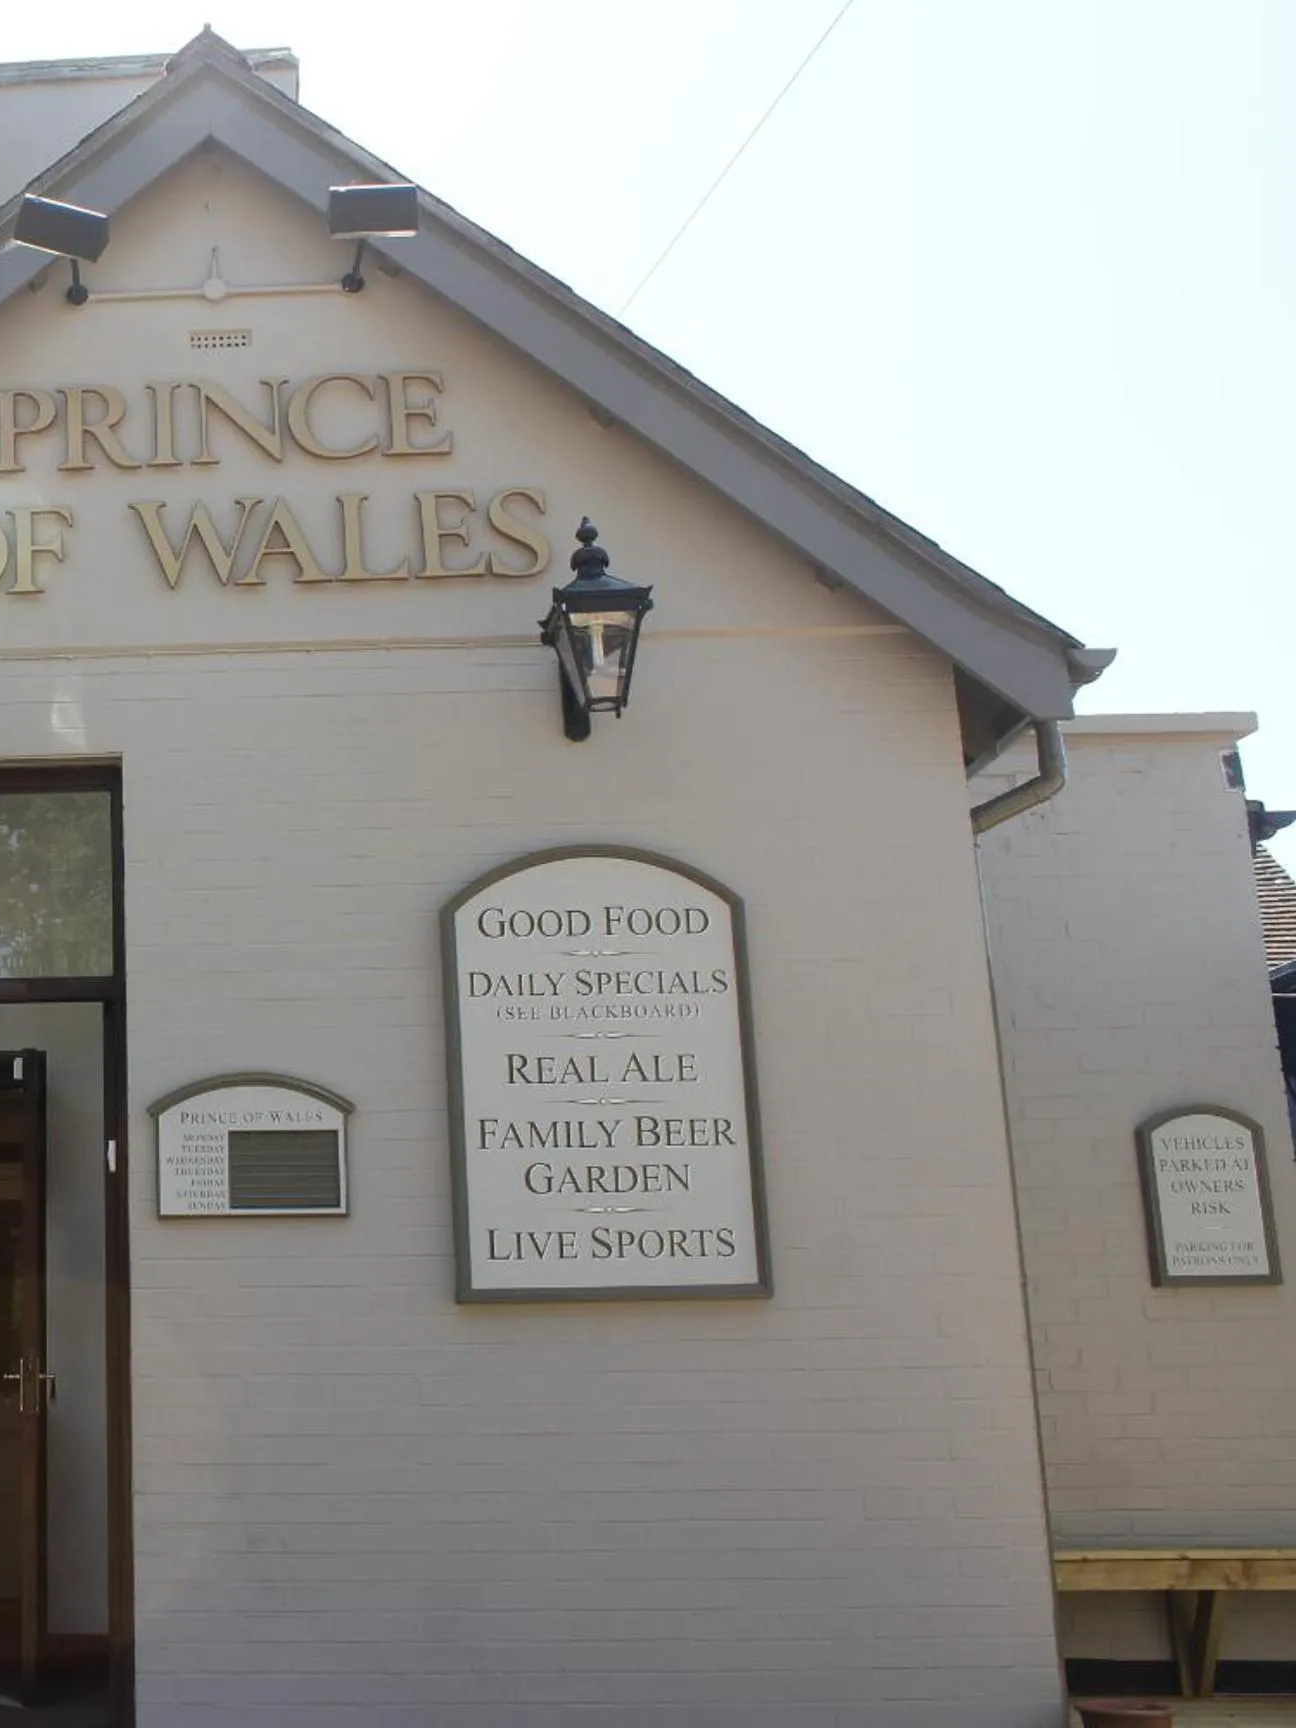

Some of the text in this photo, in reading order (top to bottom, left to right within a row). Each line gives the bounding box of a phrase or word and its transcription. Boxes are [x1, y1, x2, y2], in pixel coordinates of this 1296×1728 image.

[127, 487, 551, 590] WALES
[477, 906, 710, 940] GOOD FOOD
[468, 970, 729, 998] DAILY SPECIALS
[549, 1004, 700, 1021] BLACKBOARD)
[506, 1053, 698, 1085] REAL ALE
[180, 1111, 237, 1125] PRINCE
[270, 1111, 324, 1124] WALES
[478, 1116, 737, 1150] FAMILY BEER
[1160, 1136, 1246, 1151] VEHICLES
[525, 1163, 691, 1195] GARDEN
[1159, 1159, 1227, 1172] PARKED
[1171, 1180, 1245, 1194] OWNERS
[1191, 1202, 1232, 1215] RISK
[487, 1227, 737, 1261] LIVE SPORTS
